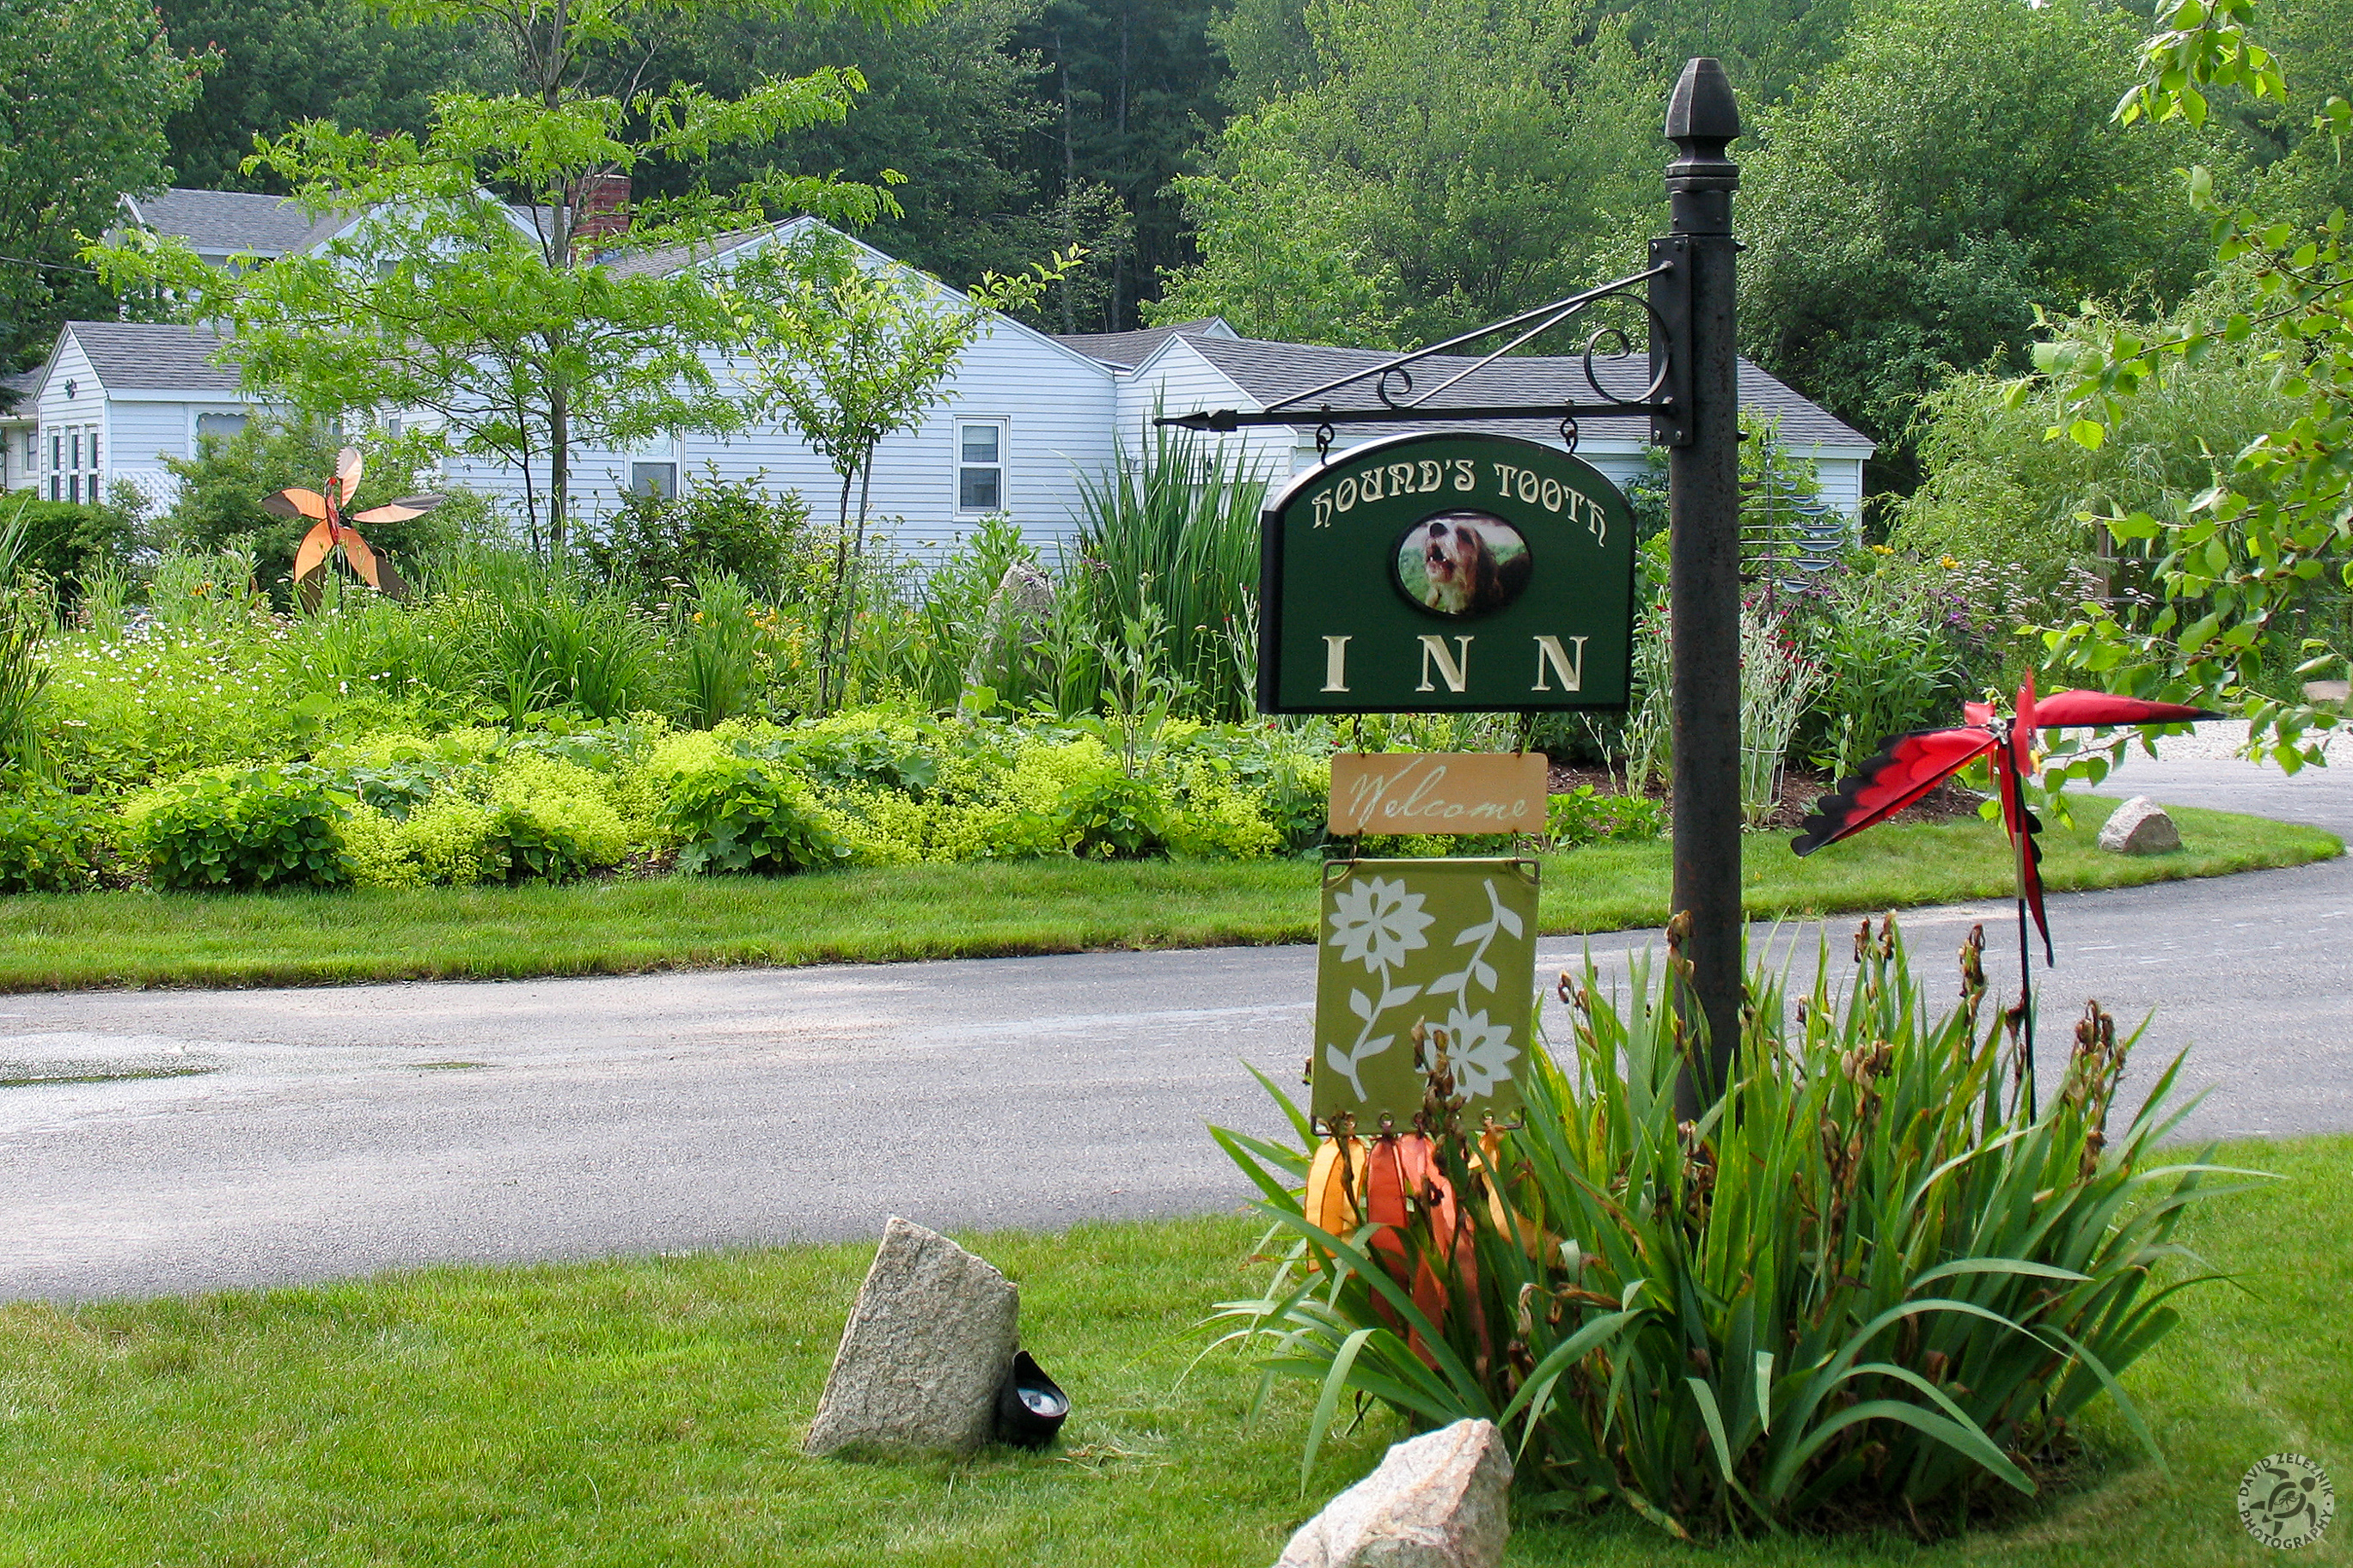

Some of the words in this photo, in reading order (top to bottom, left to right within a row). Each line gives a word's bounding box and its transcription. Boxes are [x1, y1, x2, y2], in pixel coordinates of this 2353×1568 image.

[1311, 459, 1476, 529] HOUND'S
[1493, 462, 1609, 547] TOOTH
[1349, 756, 1529, 828] Welcome
